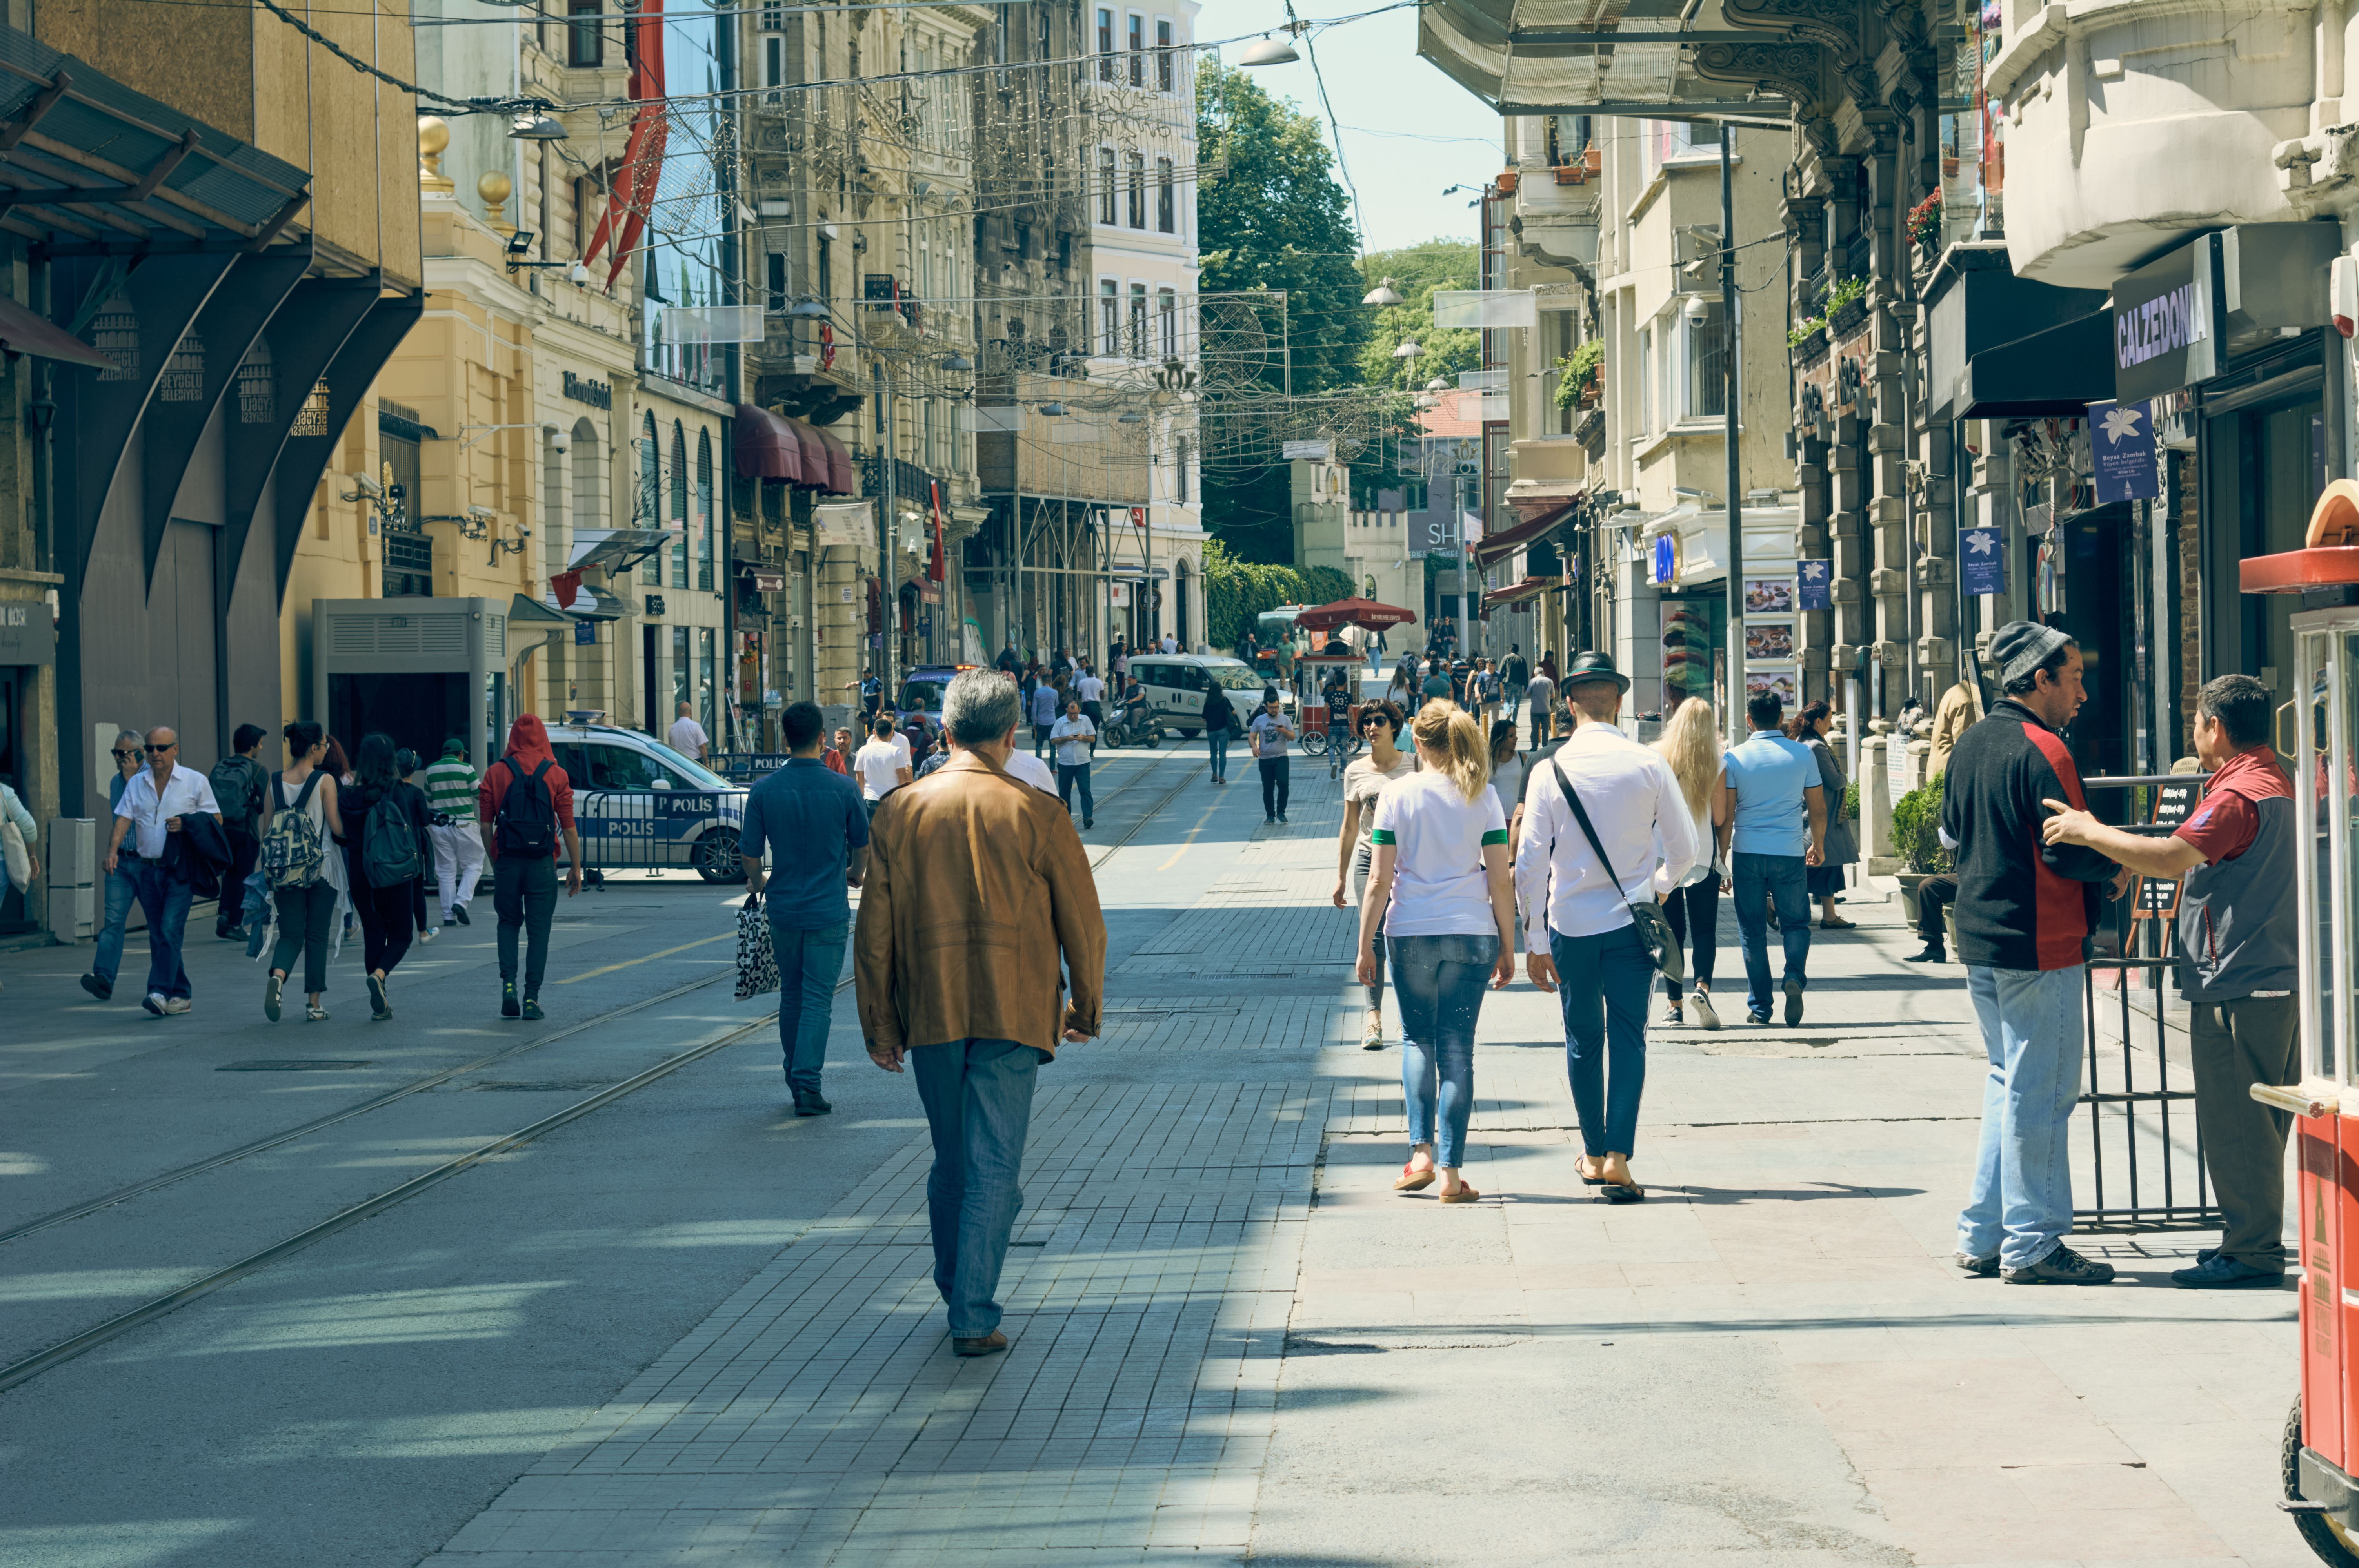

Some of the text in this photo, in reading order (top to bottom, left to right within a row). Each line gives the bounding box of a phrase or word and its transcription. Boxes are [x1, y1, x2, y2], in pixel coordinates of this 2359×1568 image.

[2118, 279, 2207, 369] CALZEDONIA
[1334, 697, 1344, 705] 93
[755, 757, 785, 769] POLİS
[673, 796, 712, 812] POLİS
[608, 819, 654, 835] POLİS
